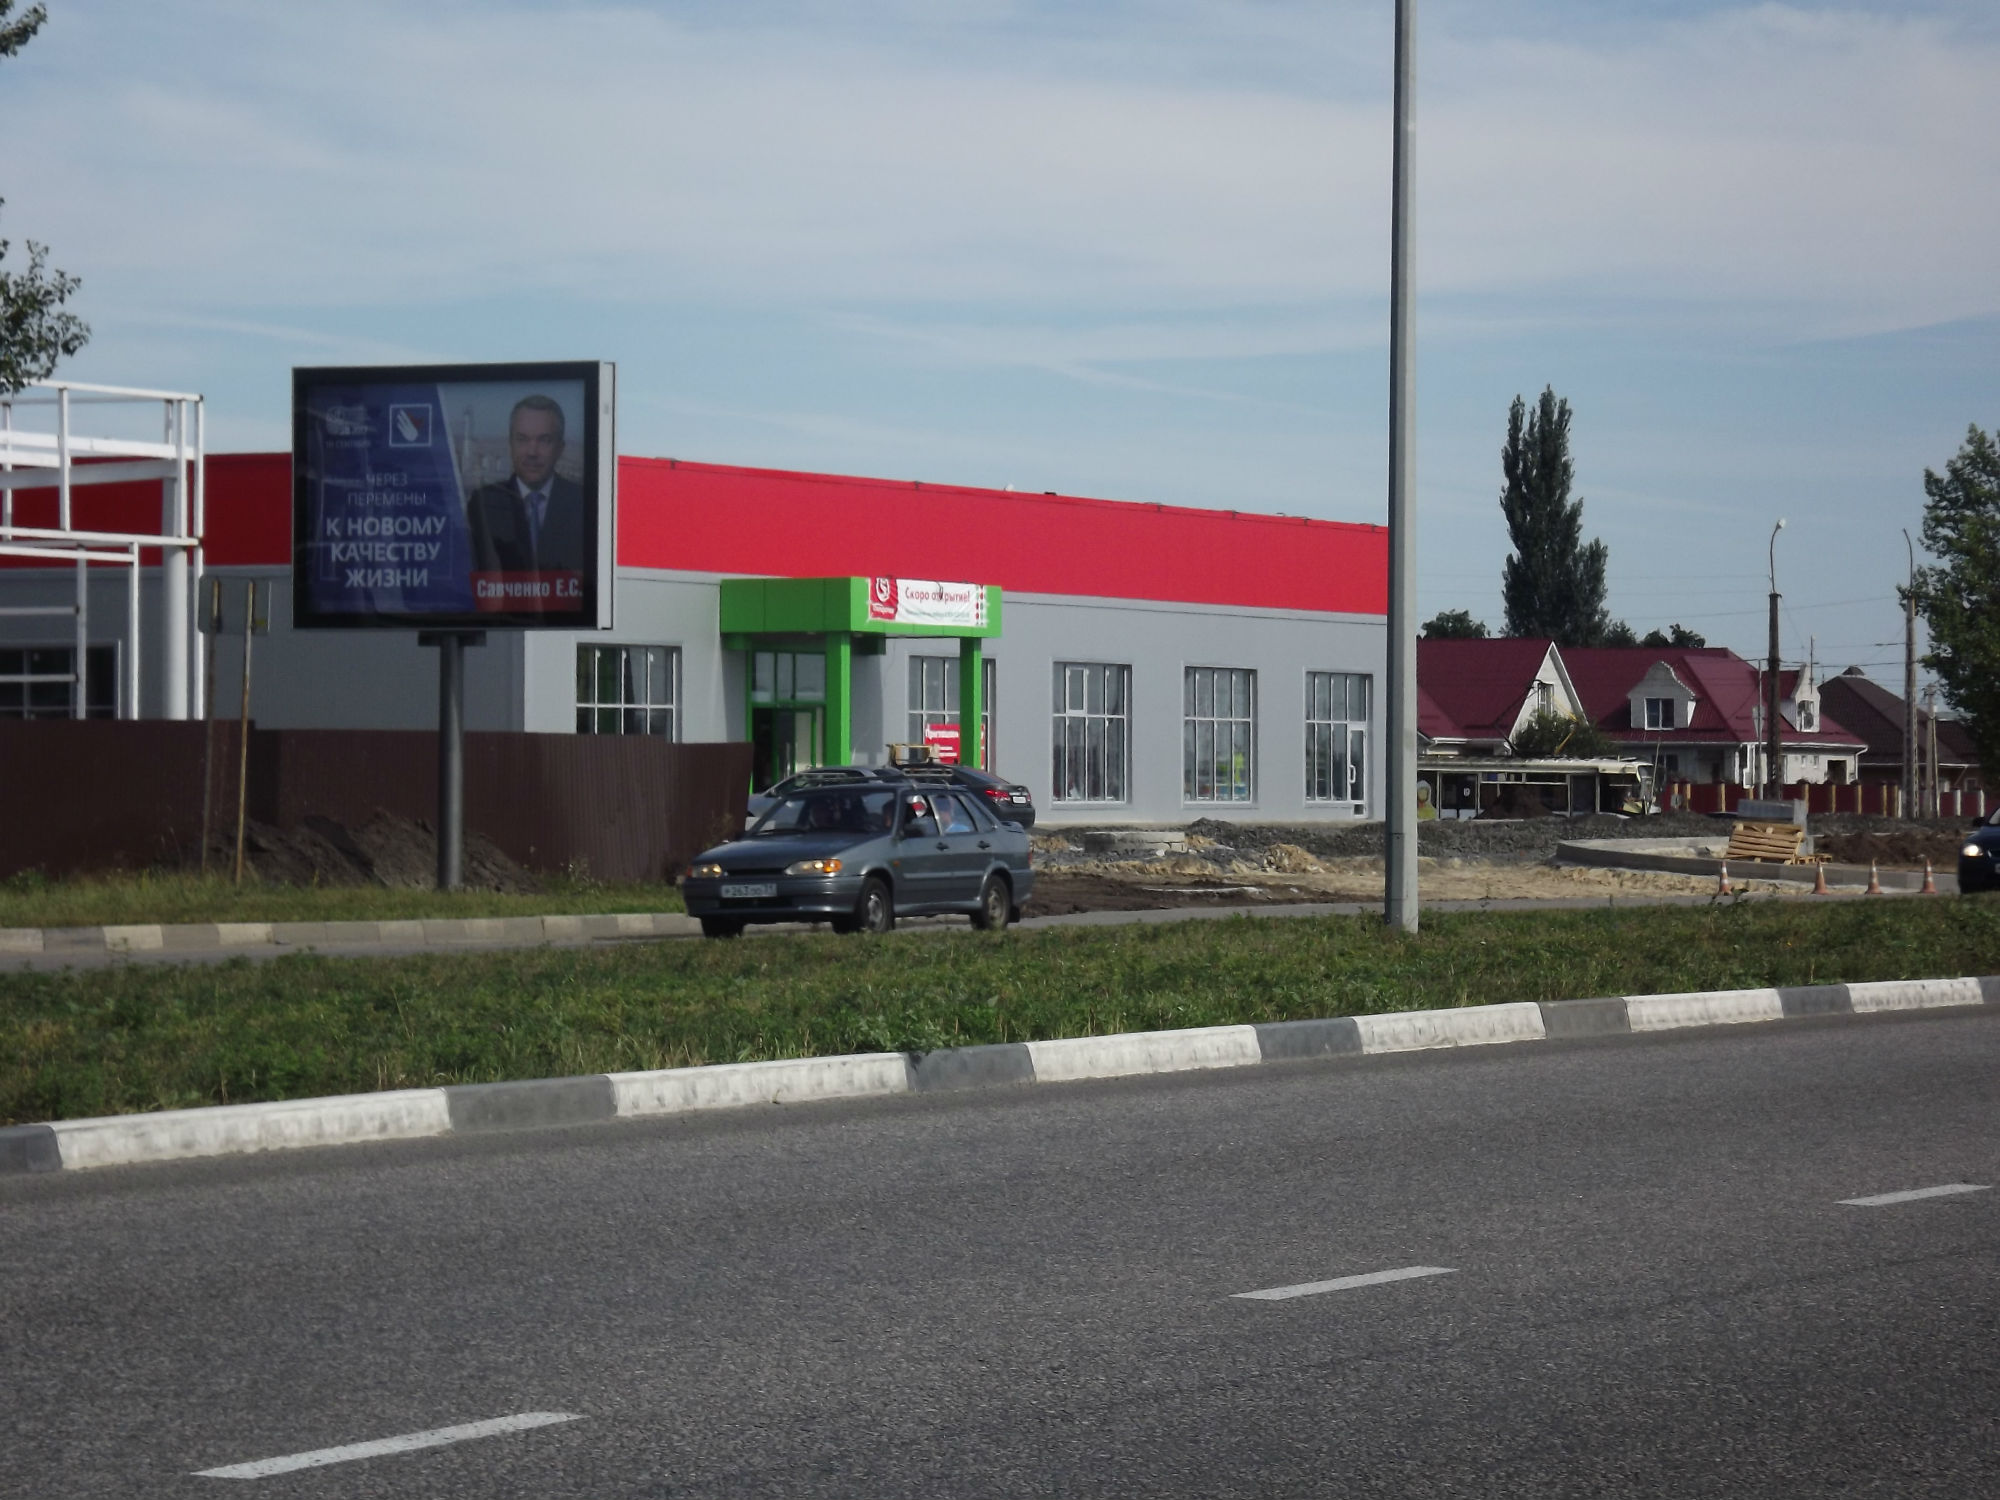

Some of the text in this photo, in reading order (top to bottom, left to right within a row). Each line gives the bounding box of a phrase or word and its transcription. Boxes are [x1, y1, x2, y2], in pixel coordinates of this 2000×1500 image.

[366, 472, 409, 486] ЧЕРЕЗ
[347, 491, 426, 506] ПЕРЕМЕНЫ
[327, 516, 447, 535] К НОВОМУ
[331, 542, 441, 562] КАЧЕСТВУ
[345, 569, 428, 588] ЖИЗНИ
[476, 578, 583, 598] Савченко Е.С.
[905, 587, 971, 604] Скоро отрытие!
